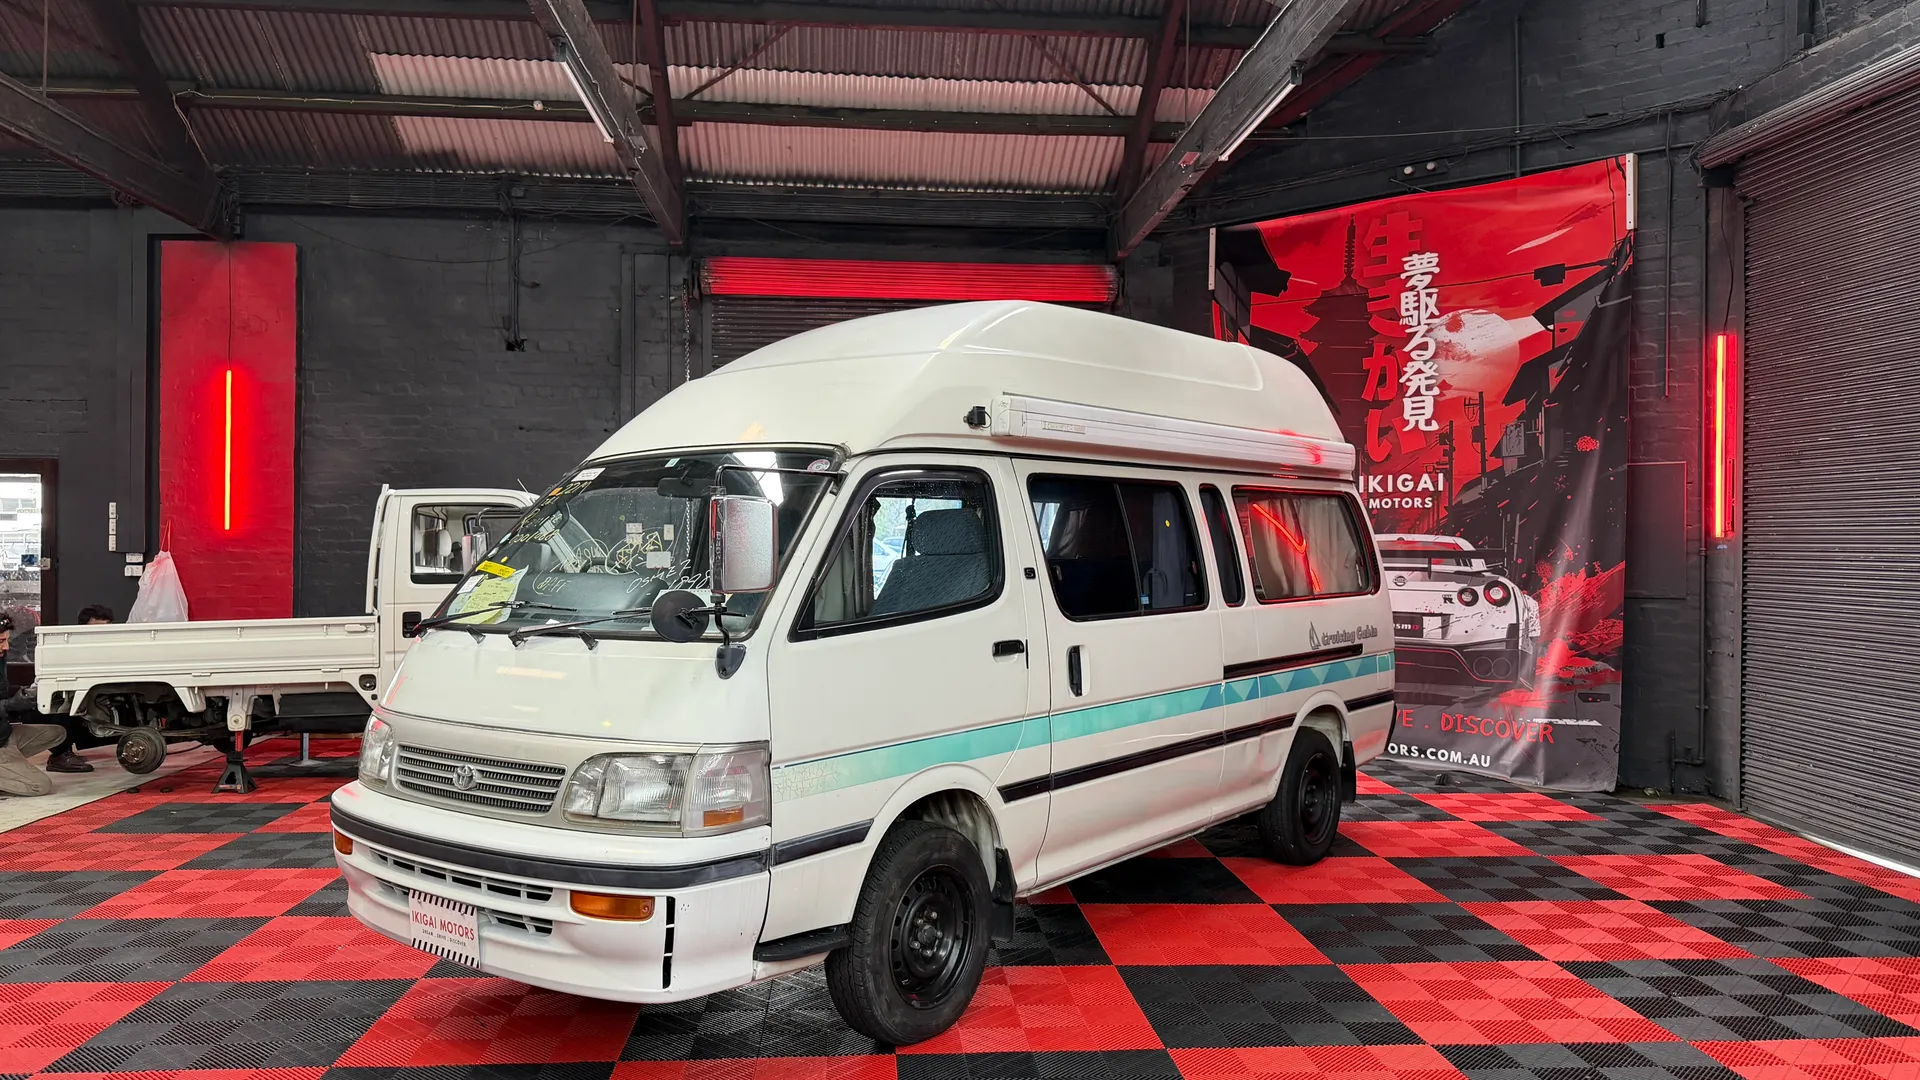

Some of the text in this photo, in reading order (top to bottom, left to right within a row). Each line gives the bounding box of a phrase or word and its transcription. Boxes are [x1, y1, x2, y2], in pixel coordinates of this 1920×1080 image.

[1399, 251, 1441, 432] 夢駆る発見
[1358, 472, 1444, 493] IKIGAI
[1368, 497, 1433, 509] MOTORS
[1322, 624, 1378, 646] Cruising Cabin
[1440, 712, 1555, 744] DISCOVER
[1387, 743, 1491, 767] ORS.COM.AU
[412, 910, 475, 941] IKIGAI MOTORS
